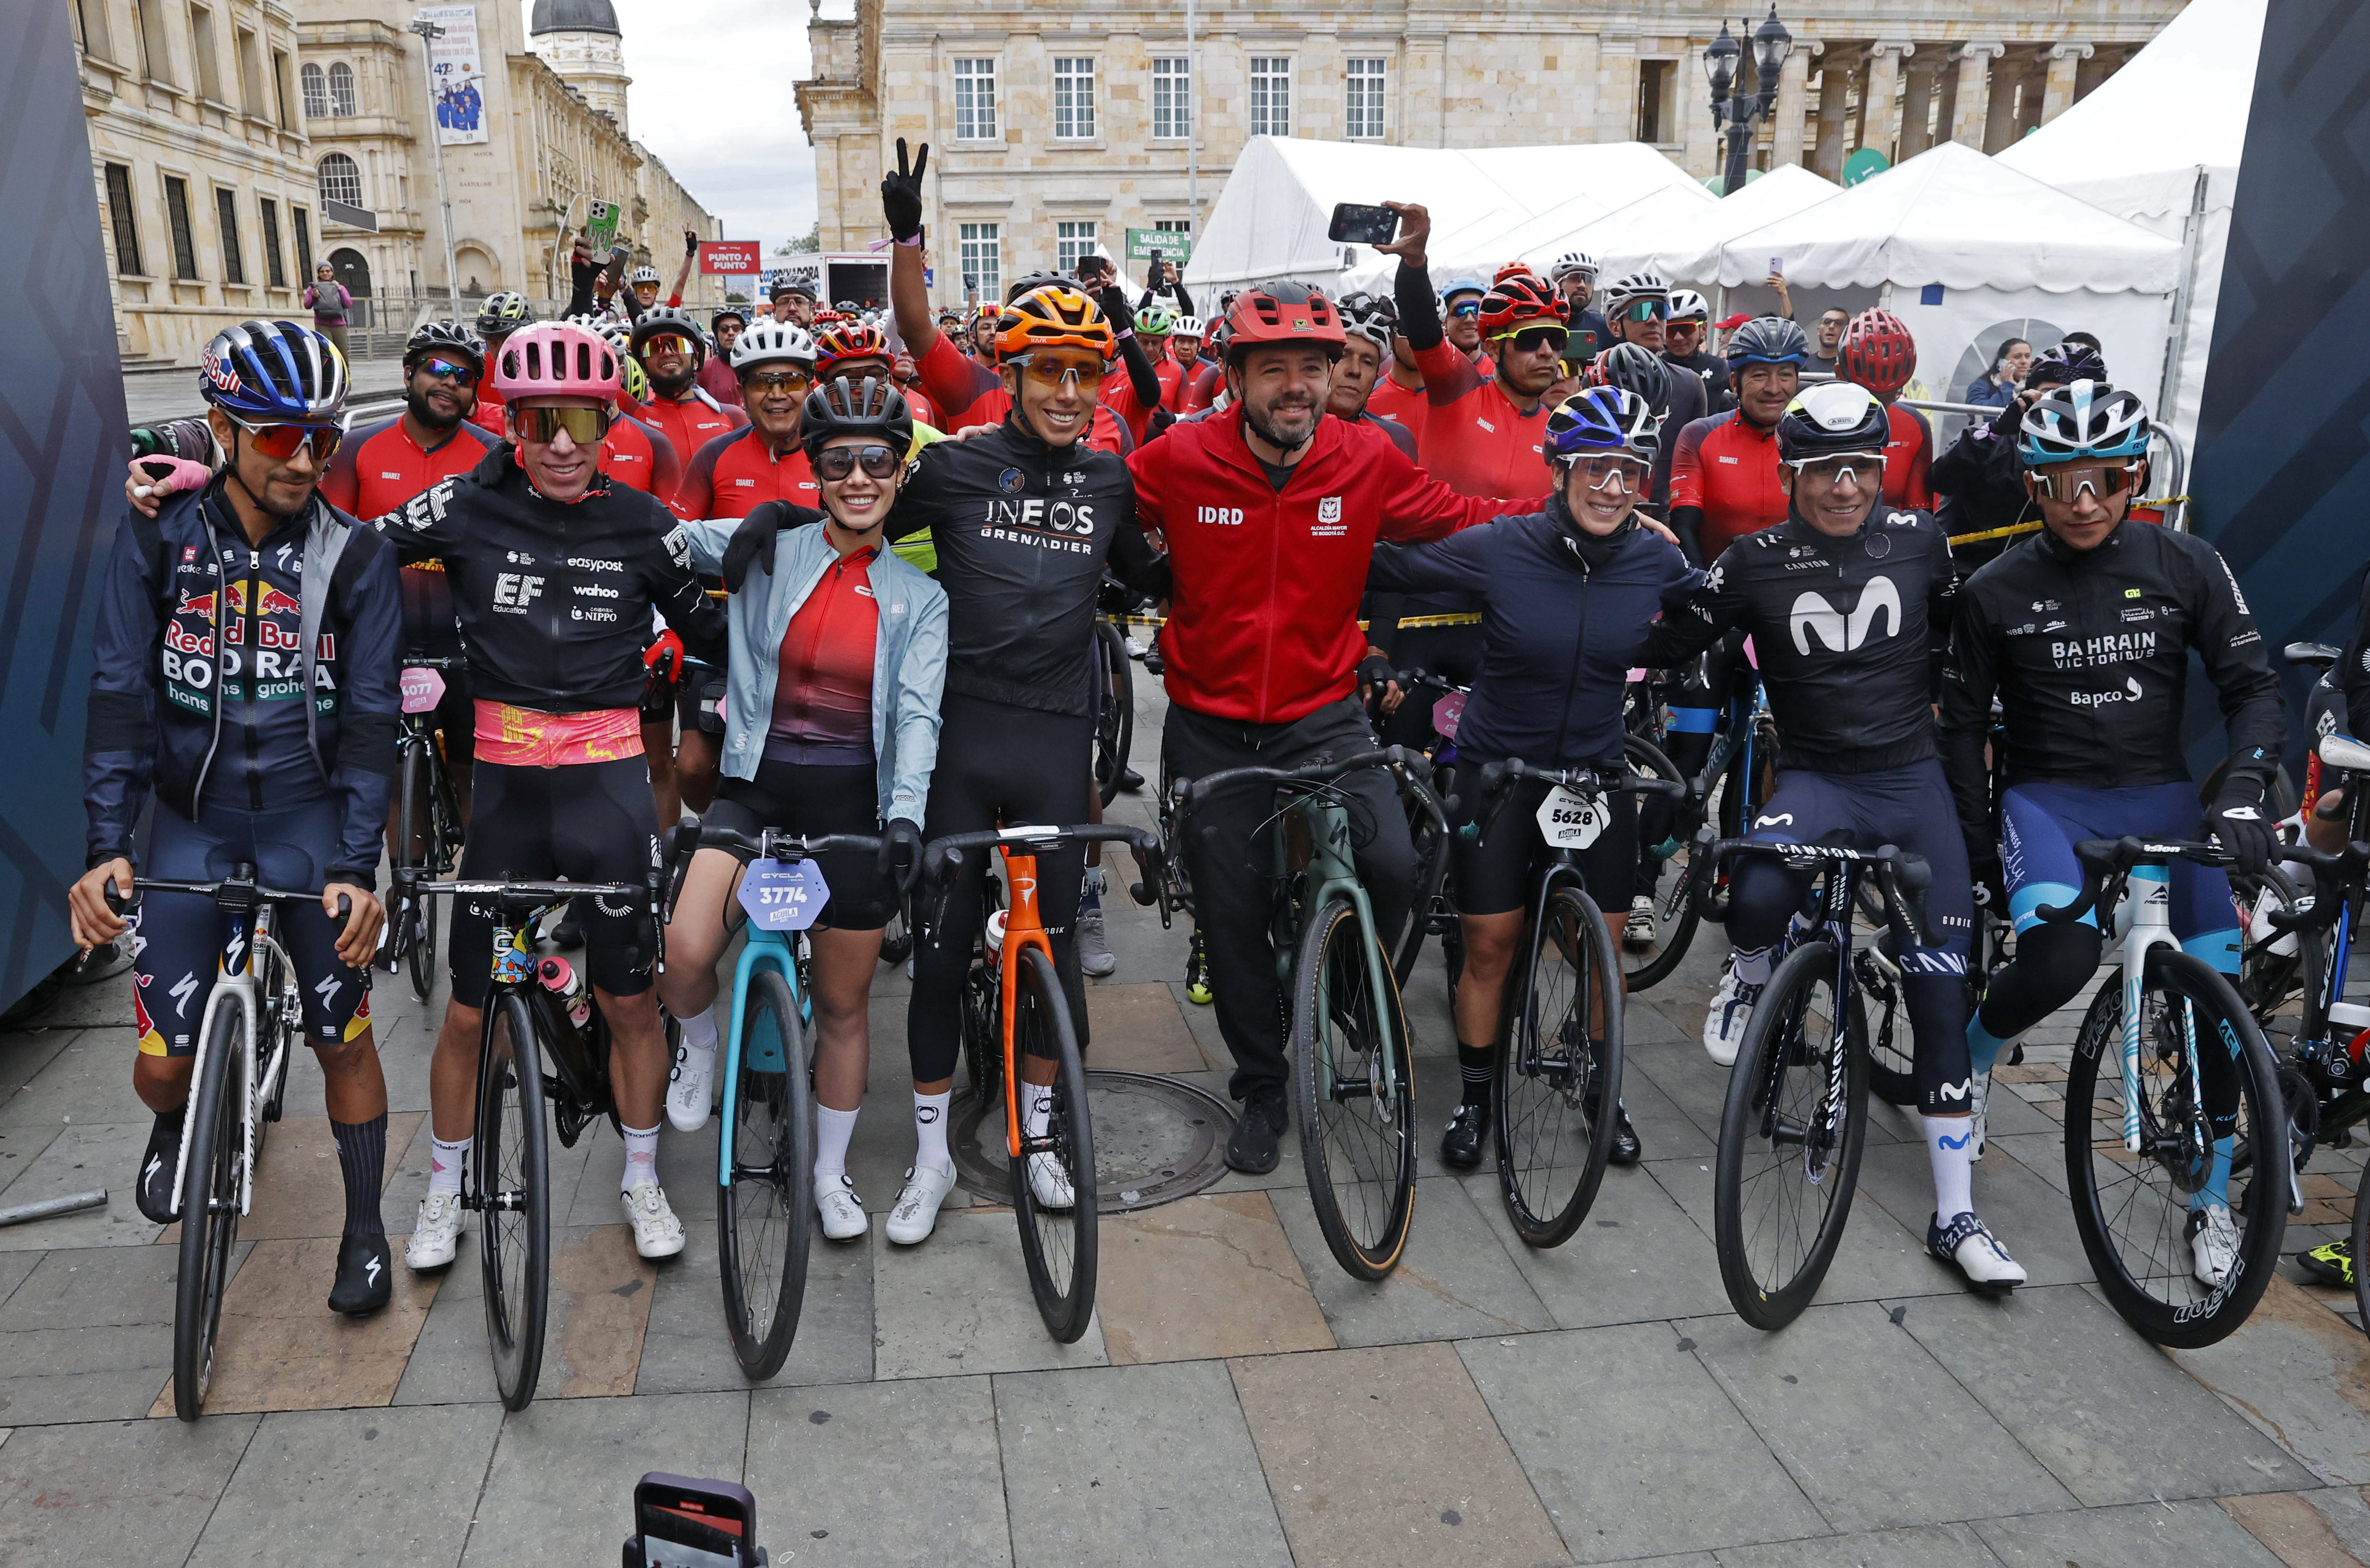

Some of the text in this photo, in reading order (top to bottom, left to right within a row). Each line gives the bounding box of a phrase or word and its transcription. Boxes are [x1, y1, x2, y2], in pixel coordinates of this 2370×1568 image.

[1139, 234, 1178, 245] SALIDA DE
[1133, 246, 1185, 257] EMEENCIA
[208, 354, 239, 397] Bull
[646, 417, 663, 428] SUAREZ
[1477, 417, 1495, 433] SUAREZ
[1719, 456, 1738, 465] SUAREZ
[735, 479, 754, 487] SUAREZ
[984, 499, 1094, 535] INEOS
[1198, 506, 1243, 525] IDRD
[568, 558, 623, 572] easypost
[1784, 560, 1830, 570] CANYON
[494, 573, 545, 606] EF
[573, 584, 619, 599] wahoo
[493, 604, 527, 615] Education
[585, 612, 617, 622] NIPPO
[2120, 608, 2155, 623] friendly
[2052, 632, 2156, 658] BAHRAIN
[2054, 648, 2156, 669] VICTORIOUS
[402, 683, 432, 696] 4077
[2071, 687, 2123, 708] Bapco
[1413, 786, 1431, 805] GRX
[1559, 798, 1588, 806] CYCL
[1552, 809, 1593, 826] 5628
[1559, 829, 1580, 839] AGUILA
[2005, 814, 2022, 851] BUSINESS
[1775, 844, 1860, 859] CANYON
[760, 887, 807, 904] 3774
[772, 908, 796, 921] AGUILA
[1942, 916, 1972, 928] GOBIK
[2080, 989, 2123, 1060] Visio
[2181, 1010, 2191, 1066] MERIDA
[1825, 1029, 1846, 1131] CANYON
